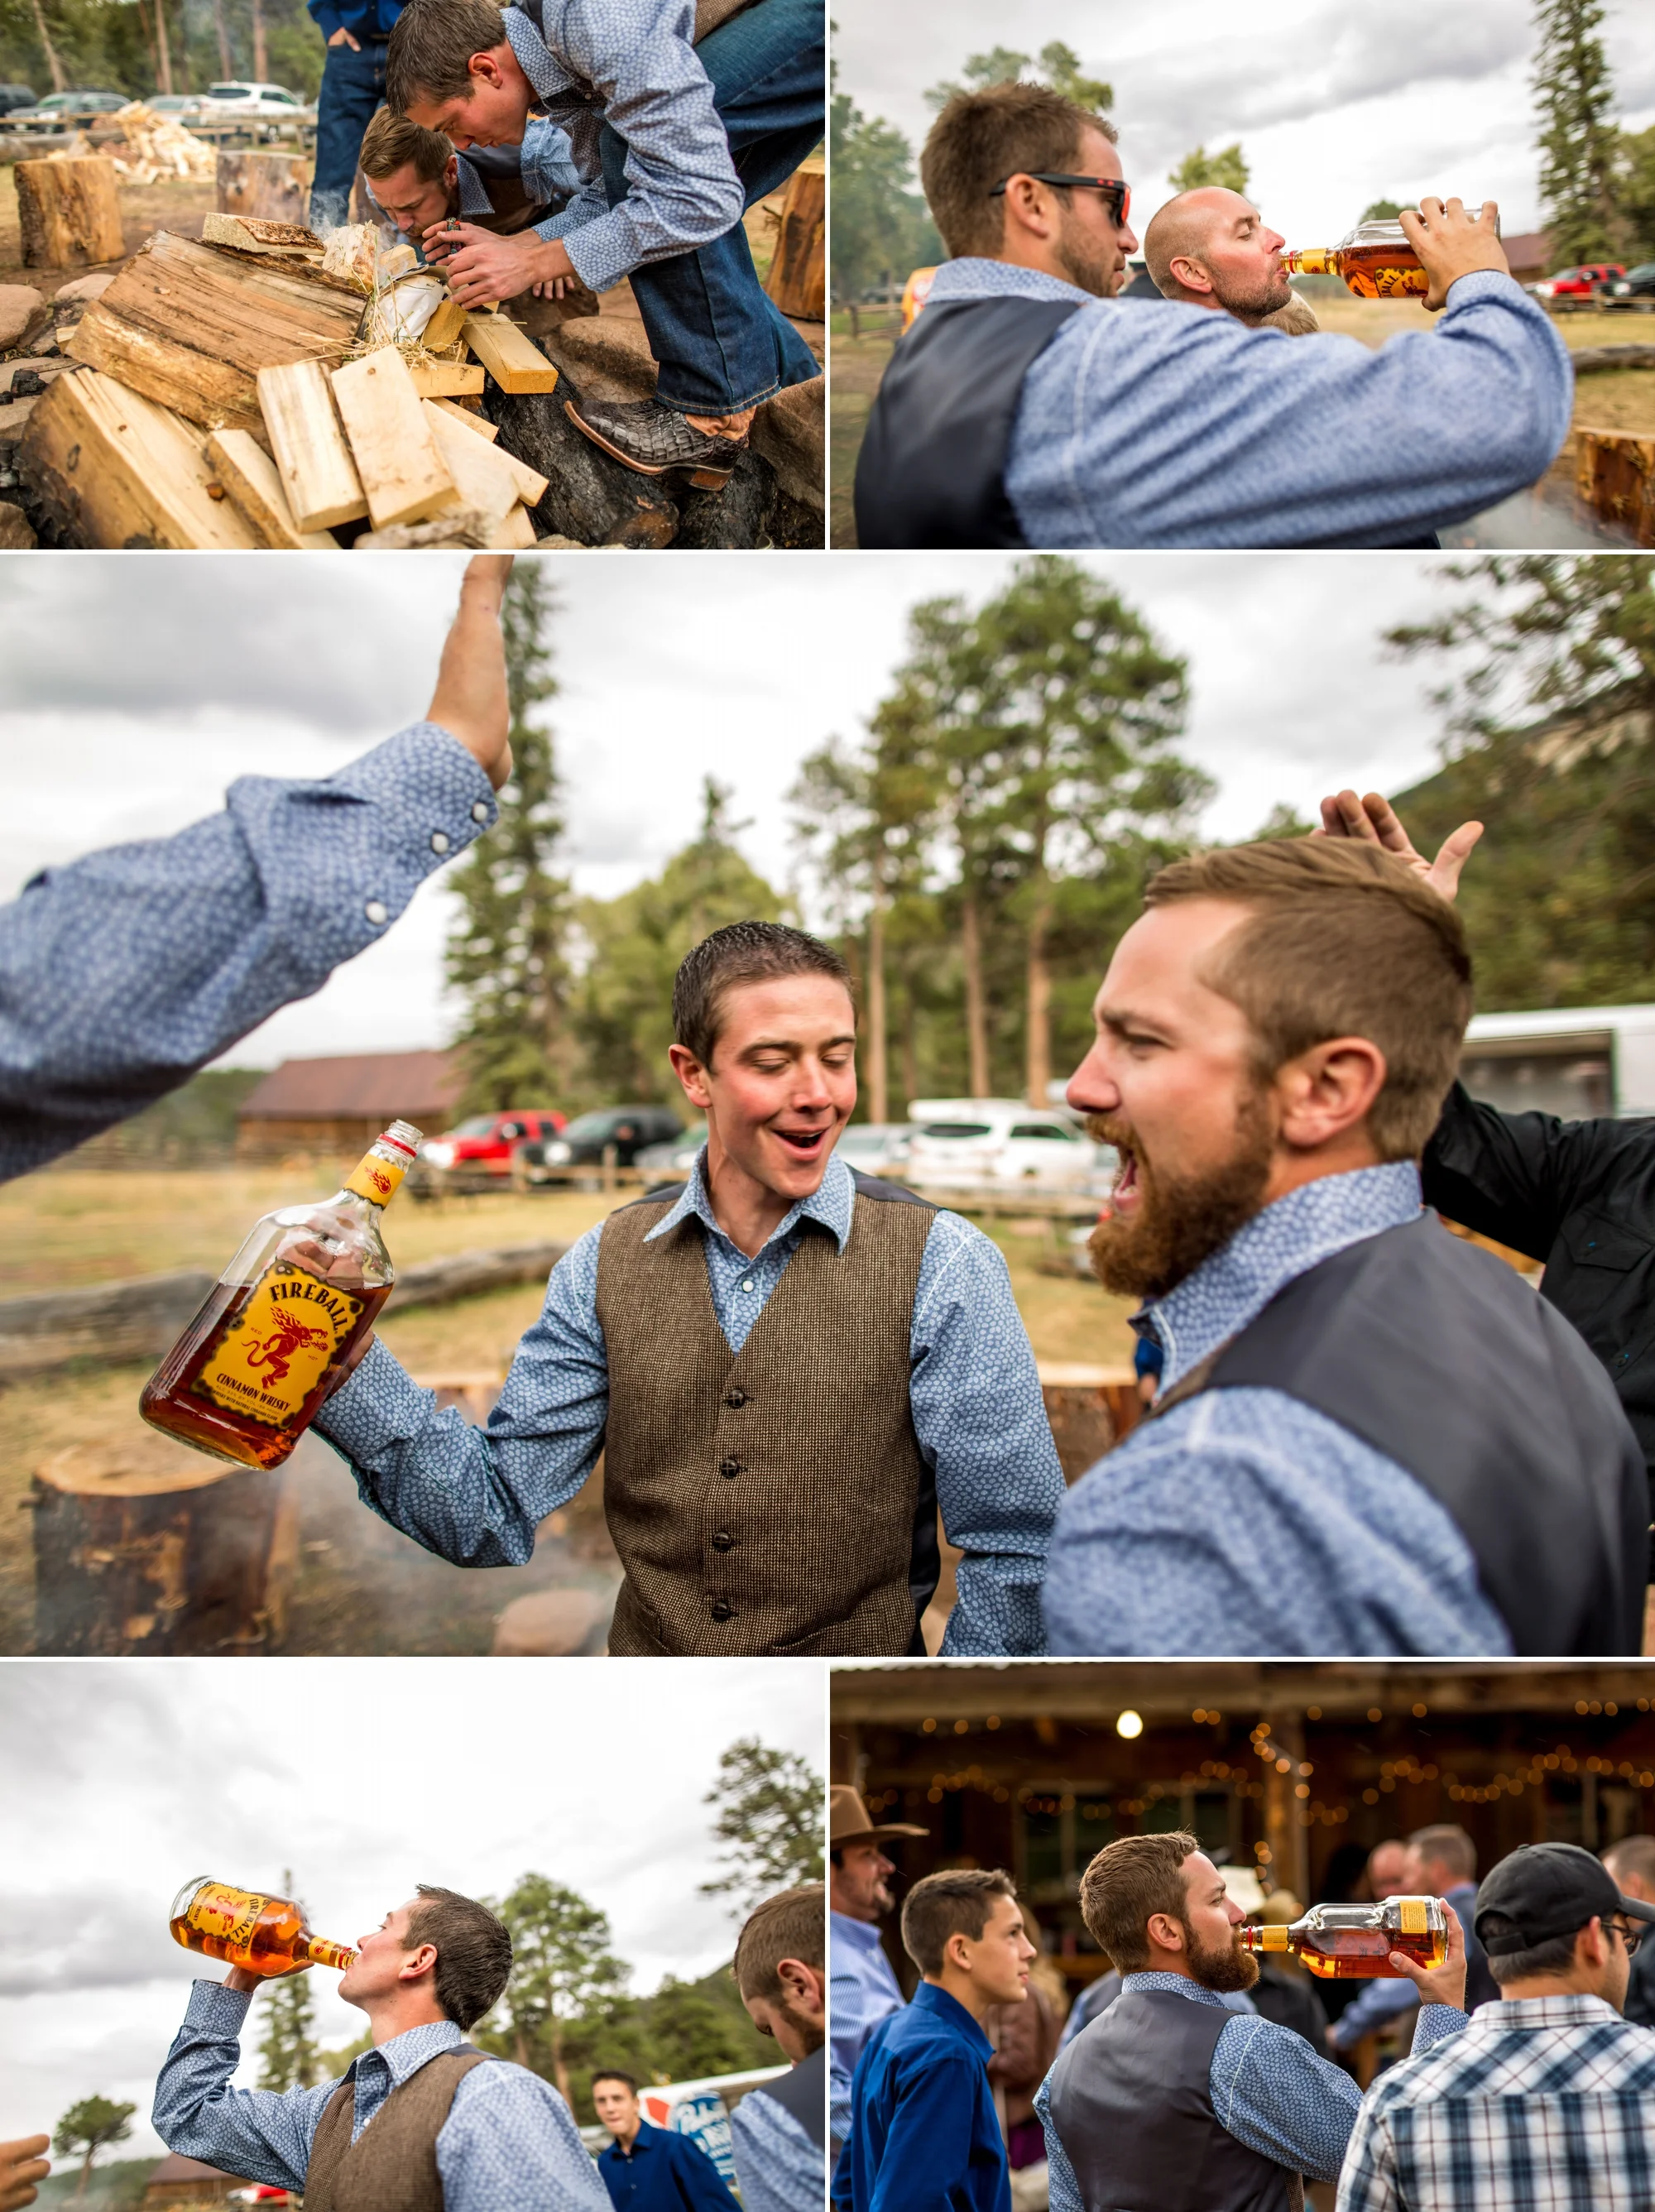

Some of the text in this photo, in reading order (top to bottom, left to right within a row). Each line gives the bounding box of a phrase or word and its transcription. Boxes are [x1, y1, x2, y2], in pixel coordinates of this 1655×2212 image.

[269, 1282, 348, 1331] FIREBALL
[250, 1327, 262, 1336] RED
[216, 1373, 291, 1412] CINNAMON WHISKY
[233, 1898, 259, 1939] FIREBALL
